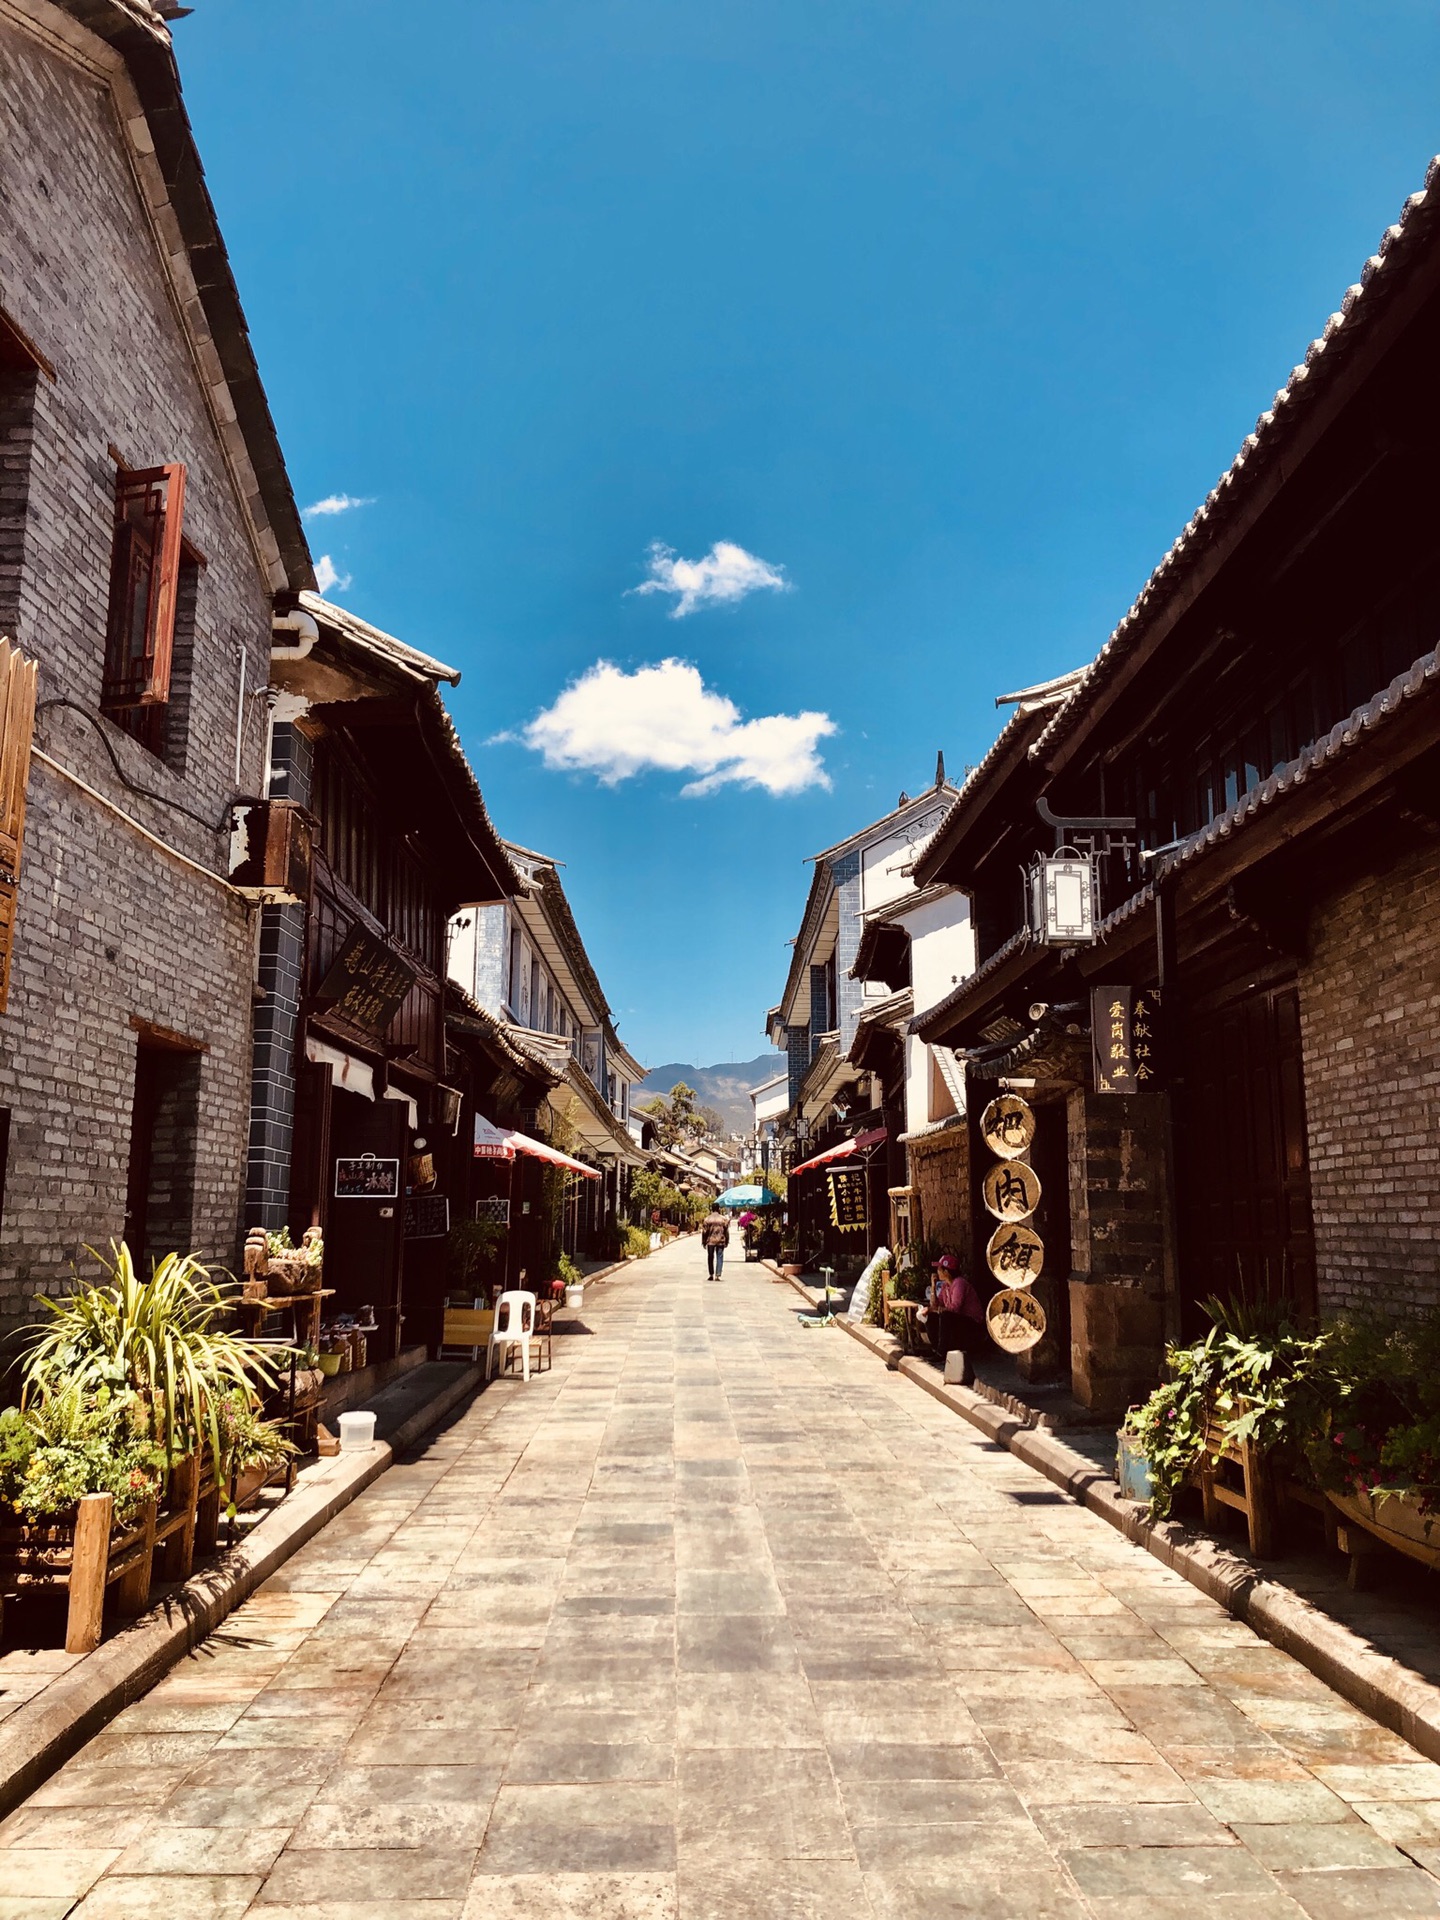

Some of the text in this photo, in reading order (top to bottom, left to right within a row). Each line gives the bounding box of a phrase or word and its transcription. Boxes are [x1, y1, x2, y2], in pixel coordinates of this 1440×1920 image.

[1108, 999, 1130, 1079] 爱岗敬业
[1132, 999, 1155, 1080] 奉献社会
[348, 1161, 383, 1171] 手工制作
[364, 1171, 396, 1194] 冰棒
